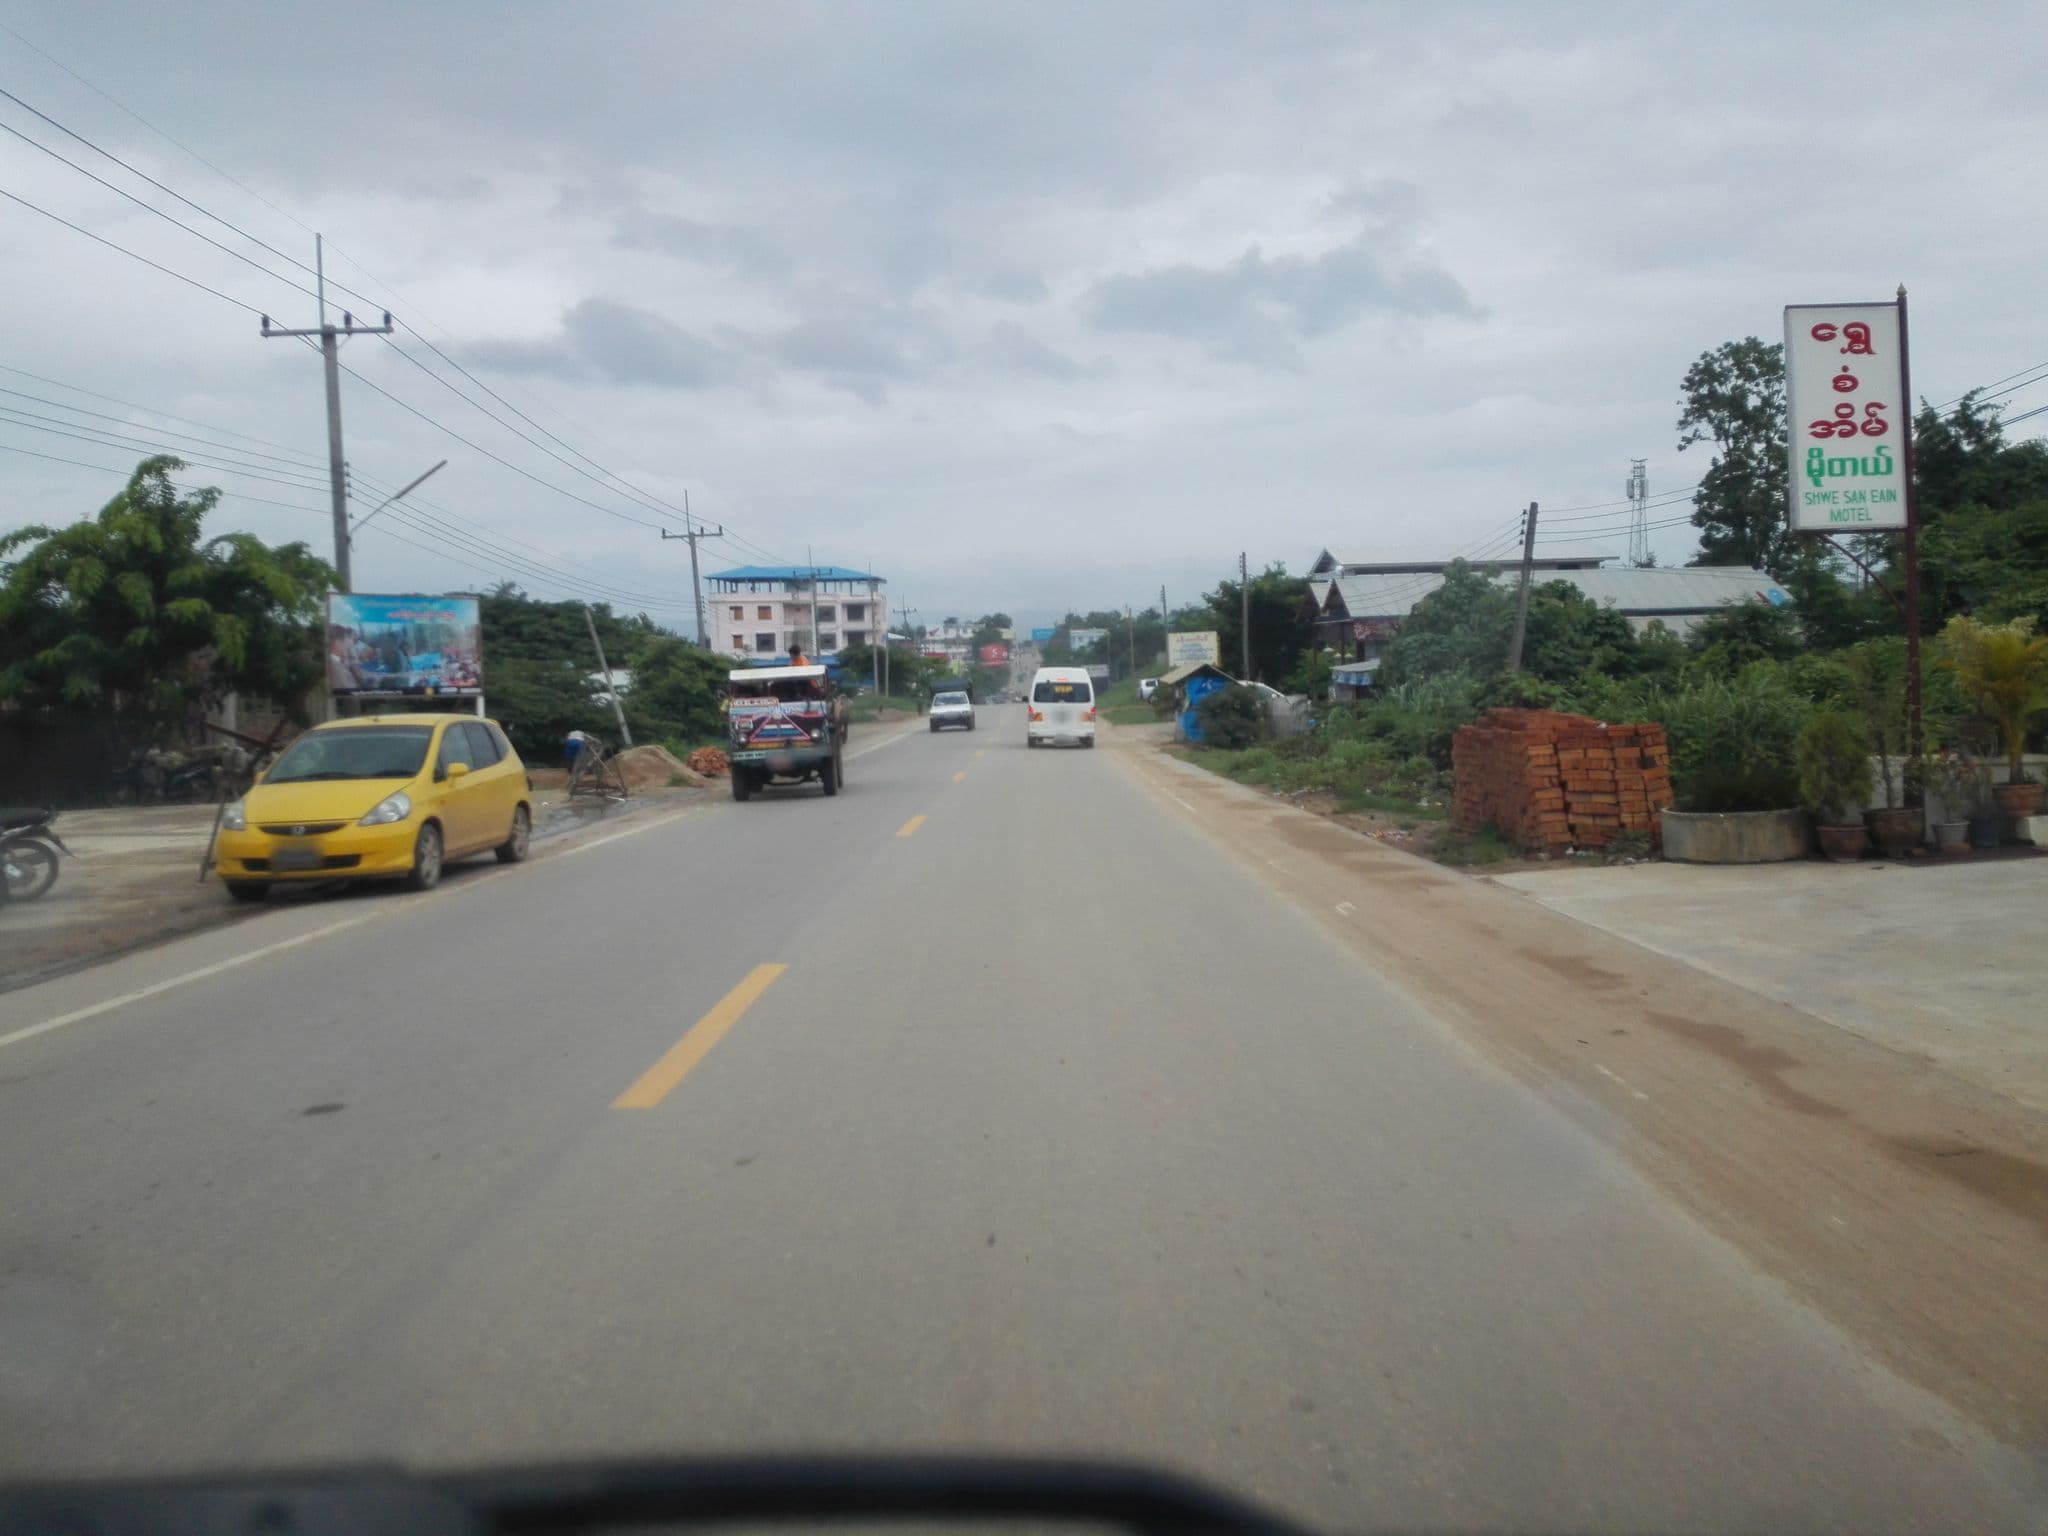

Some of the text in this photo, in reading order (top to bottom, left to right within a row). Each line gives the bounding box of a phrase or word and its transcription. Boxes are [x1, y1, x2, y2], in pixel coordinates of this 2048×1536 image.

[1804, 488, 1897, 505] SHWE SAN EAIN
[1829, 507, 1873, 523] MOTEL
